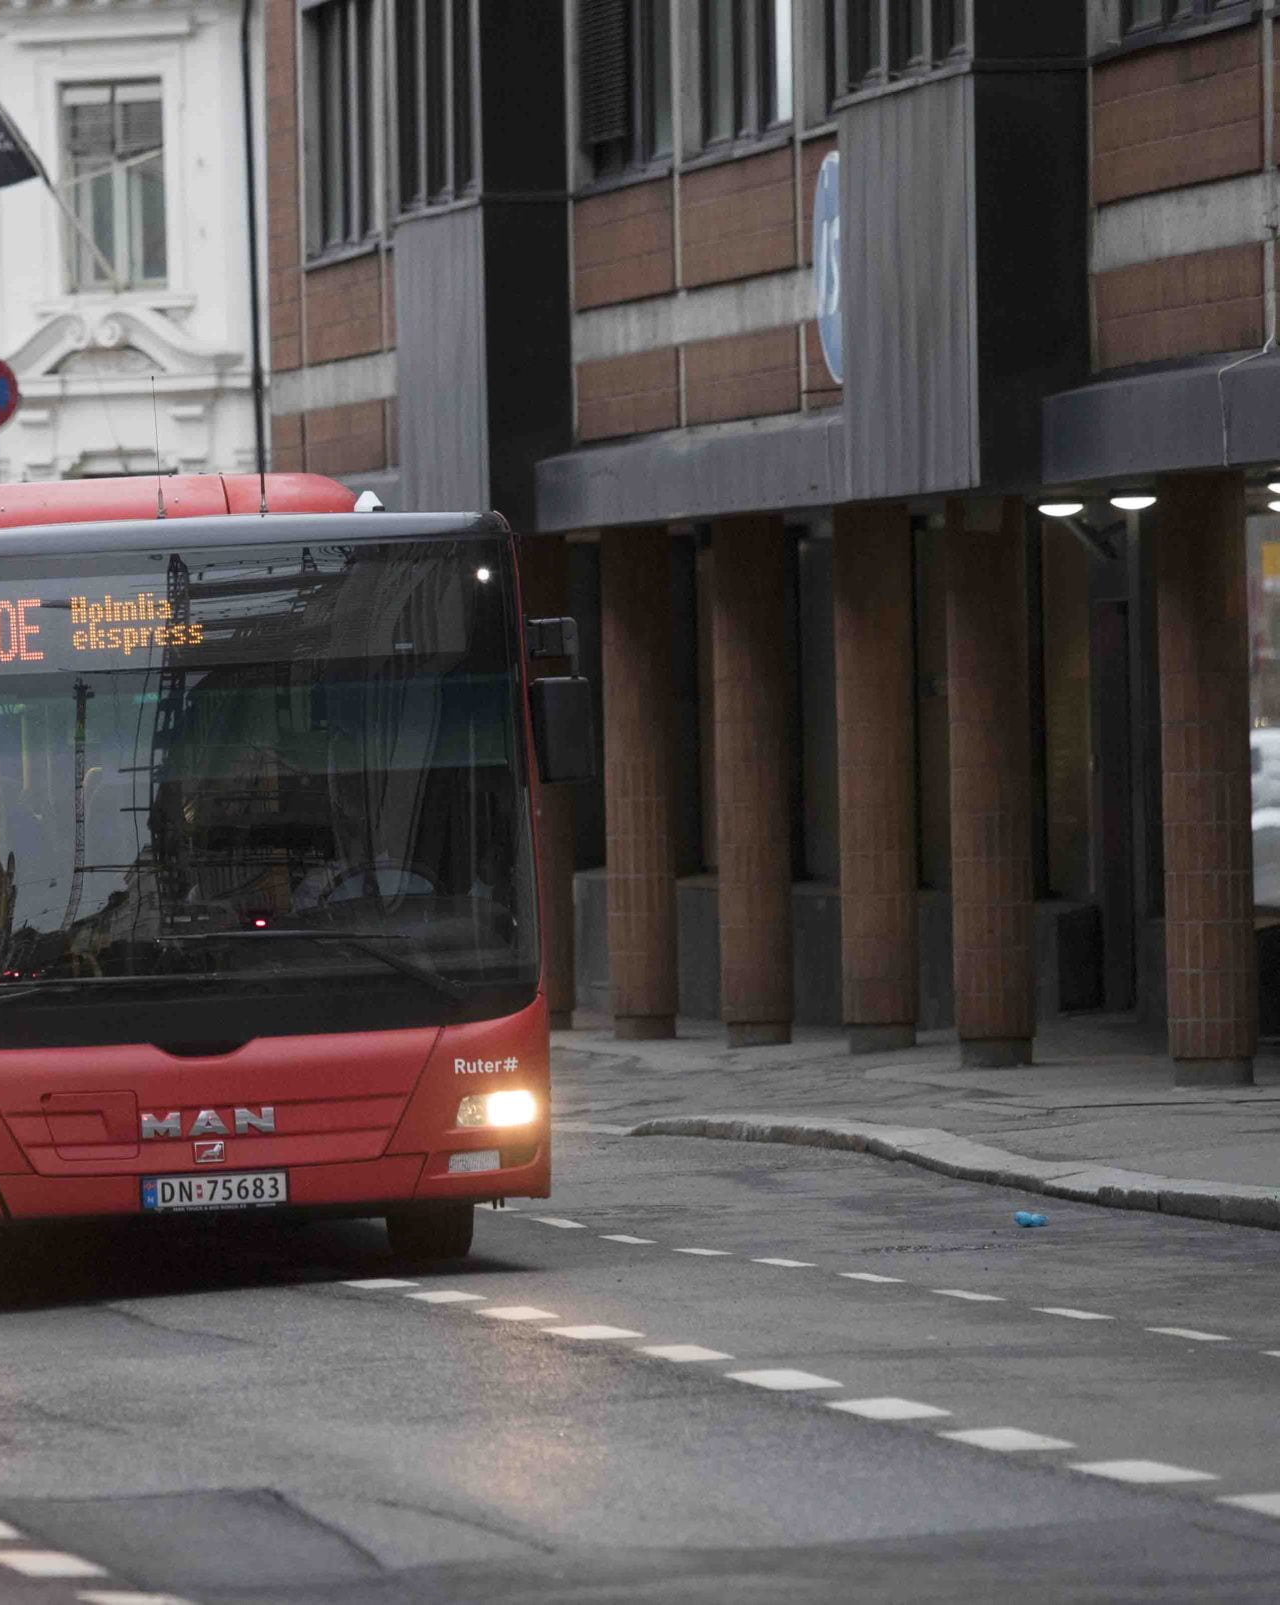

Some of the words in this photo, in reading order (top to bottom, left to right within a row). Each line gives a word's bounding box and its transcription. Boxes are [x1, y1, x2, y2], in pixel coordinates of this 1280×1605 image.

[71, 592, 173, 625] Holmlia
[72, 622, 204, 656] ekspress
[453, 1055, 519, 1074] Ruter#
[141, 1106, 276, 1138] MAN
[161, 1180, 193, 1204] DN
[206, 1176, 280, 1201] 75683
